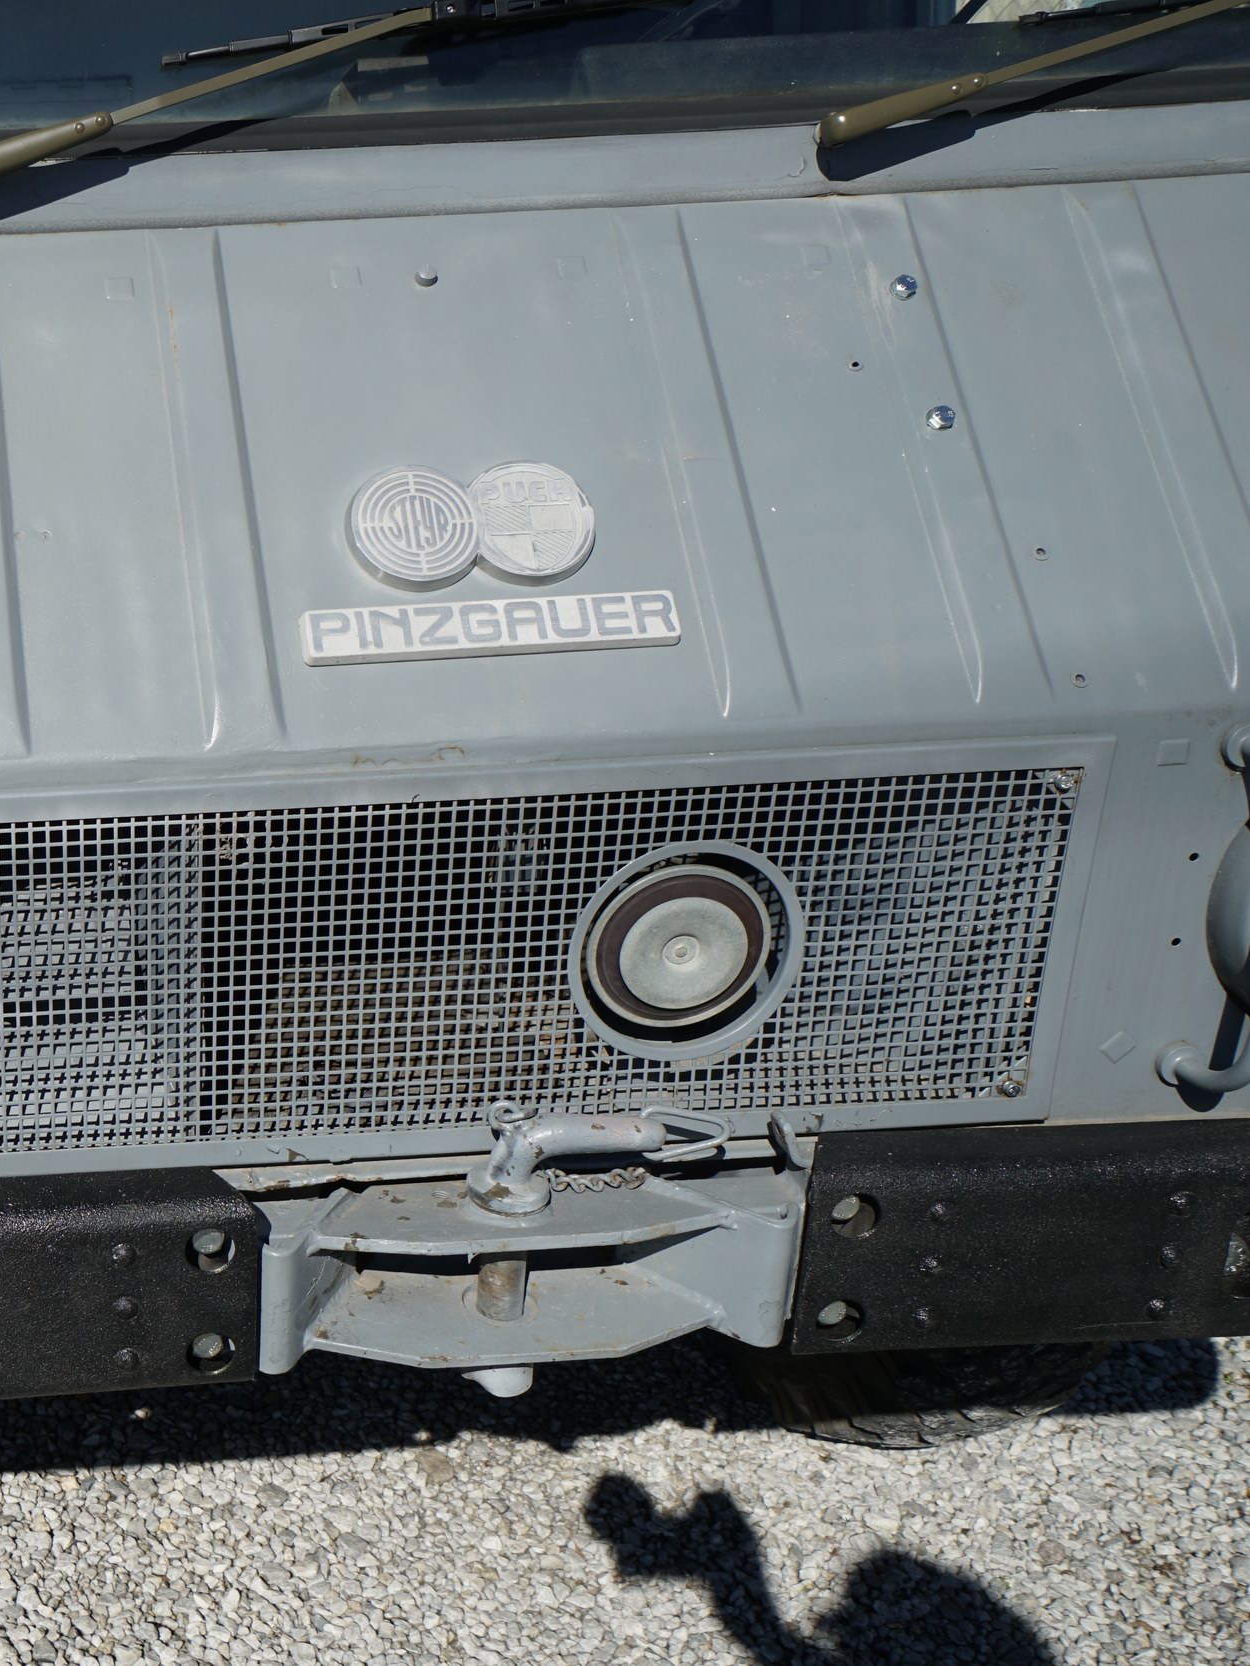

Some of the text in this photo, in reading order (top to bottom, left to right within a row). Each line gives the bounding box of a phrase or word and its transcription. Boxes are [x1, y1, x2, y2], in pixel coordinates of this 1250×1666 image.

[478, 478, 573, 505] PUCH
[387, 494, 450, 552] STEYR
[310, 593, 677, 653] PINZGAUER
